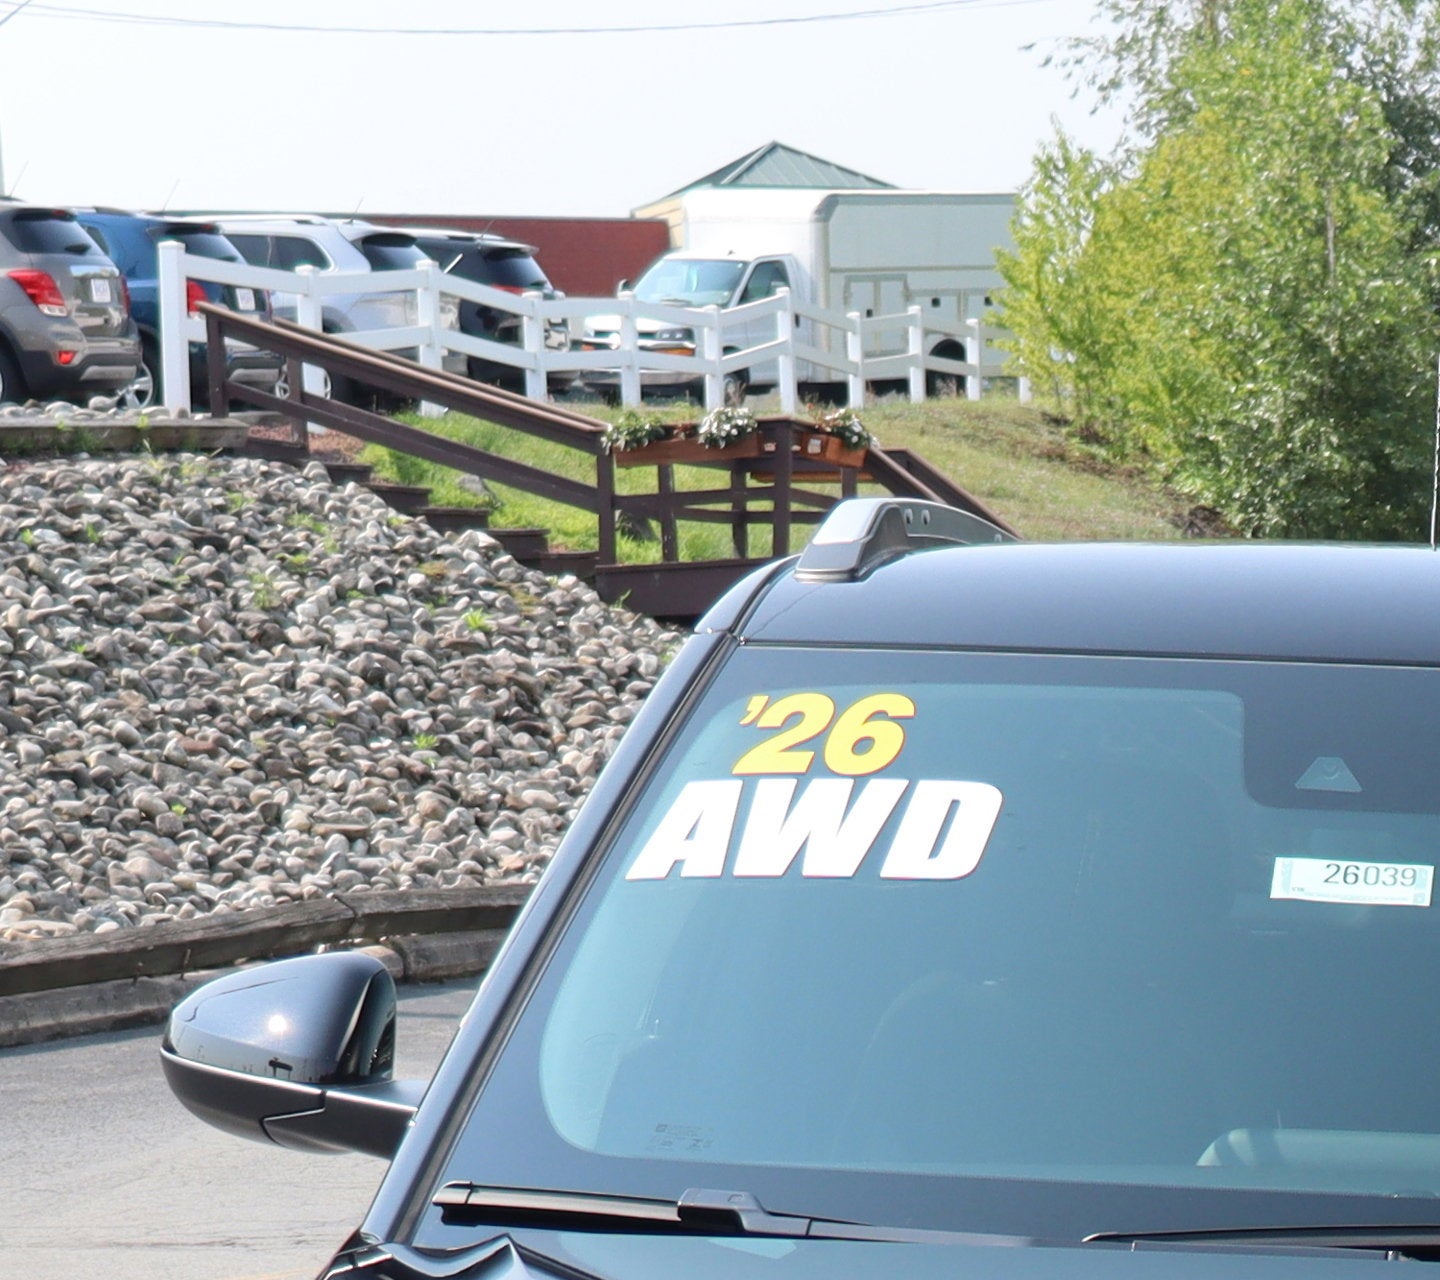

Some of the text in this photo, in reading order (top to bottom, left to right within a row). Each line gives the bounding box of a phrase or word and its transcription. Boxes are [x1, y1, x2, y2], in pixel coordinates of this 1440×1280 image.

[732, 692, 916, 777] '26
[625, 778, 1004, 881] AWD
[1323, 863, 1417, 887] 26039
